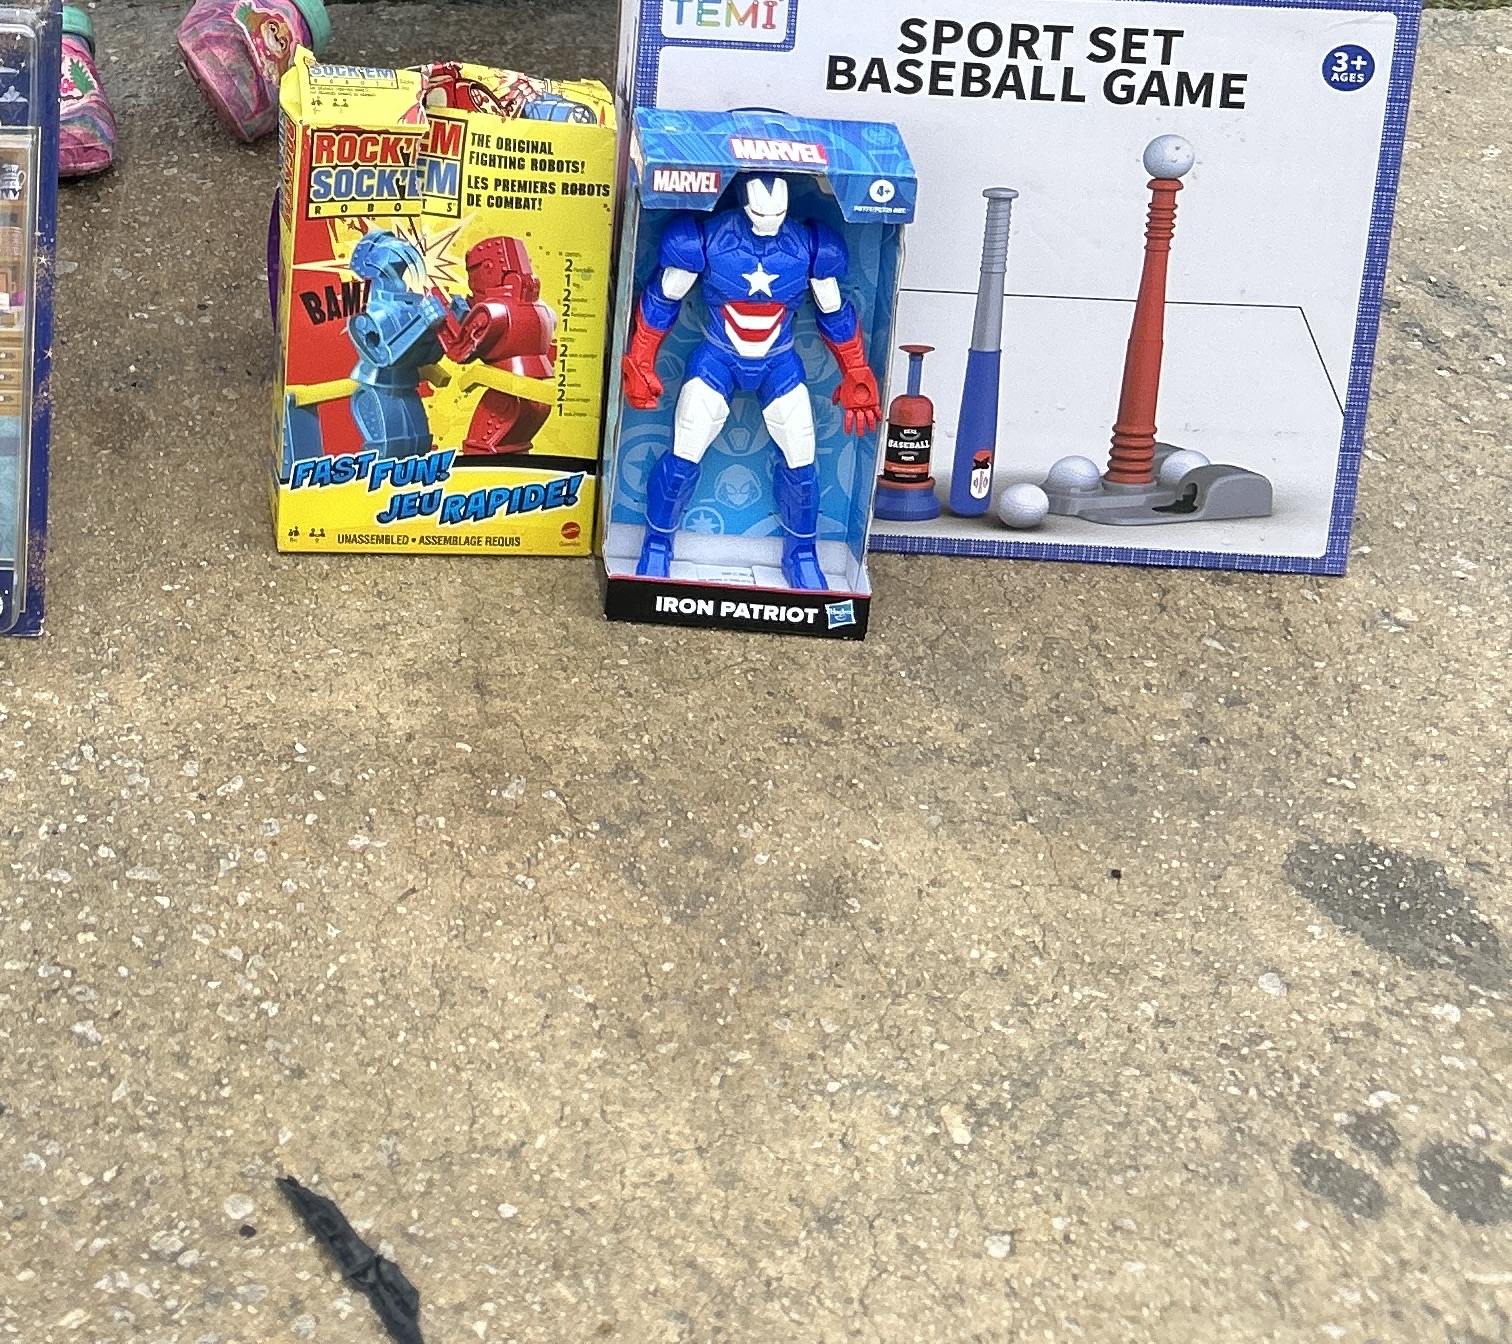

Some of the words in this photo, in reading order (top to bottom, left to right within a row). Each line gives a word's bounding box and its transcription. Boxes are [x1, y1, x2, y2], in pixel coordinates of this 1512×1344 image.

[897, 18, 1073, 61] SPORT
[1086, 26, 1184, 65] SET
[1332, 51, 1367, 71] 3+
[826, 55, 1086, 102] BASEBALL
[1103, 69, 1248, 109] GAME
[1331, 73, 1364, 83] AGES
[471, 132, 491, 148] THE
[496, 137, 554, 155] ORIGINAL
[730, 138, 828, 164] MARVEL
[469, 151, 525, 170] FIGHTING
[531, 158, 585, 174] ROBOTS!
[311, 160, 457, 201] SOCK'EM
[468, 175, 488, 190] LES
[494, 178, 556, 194] PREMIERS
[561, 182, 610, 197] ROBOTS
[653, 170, 717, 193] MARVEL
[467, 193, 482, 207] DE
[487, 195, 543, 211] COMBAT!
[299, 279, 372, 325] BAM!
[291, 452, 376, 490] FAST
[368, 449, 456, 492] FUN!
[376, 488, 443, 524] JEU
[439, 473, 584, 525] RAPIDE!
[338, 534, 409, 545] UNASSEMBLED
[419, 535, 482, 546] ASSEMBLAGE
[485, 537, 520, 547] REQUIS
[656, 596, 714, 616] IRON
[720, 600, 819, 623] PATRIOT
